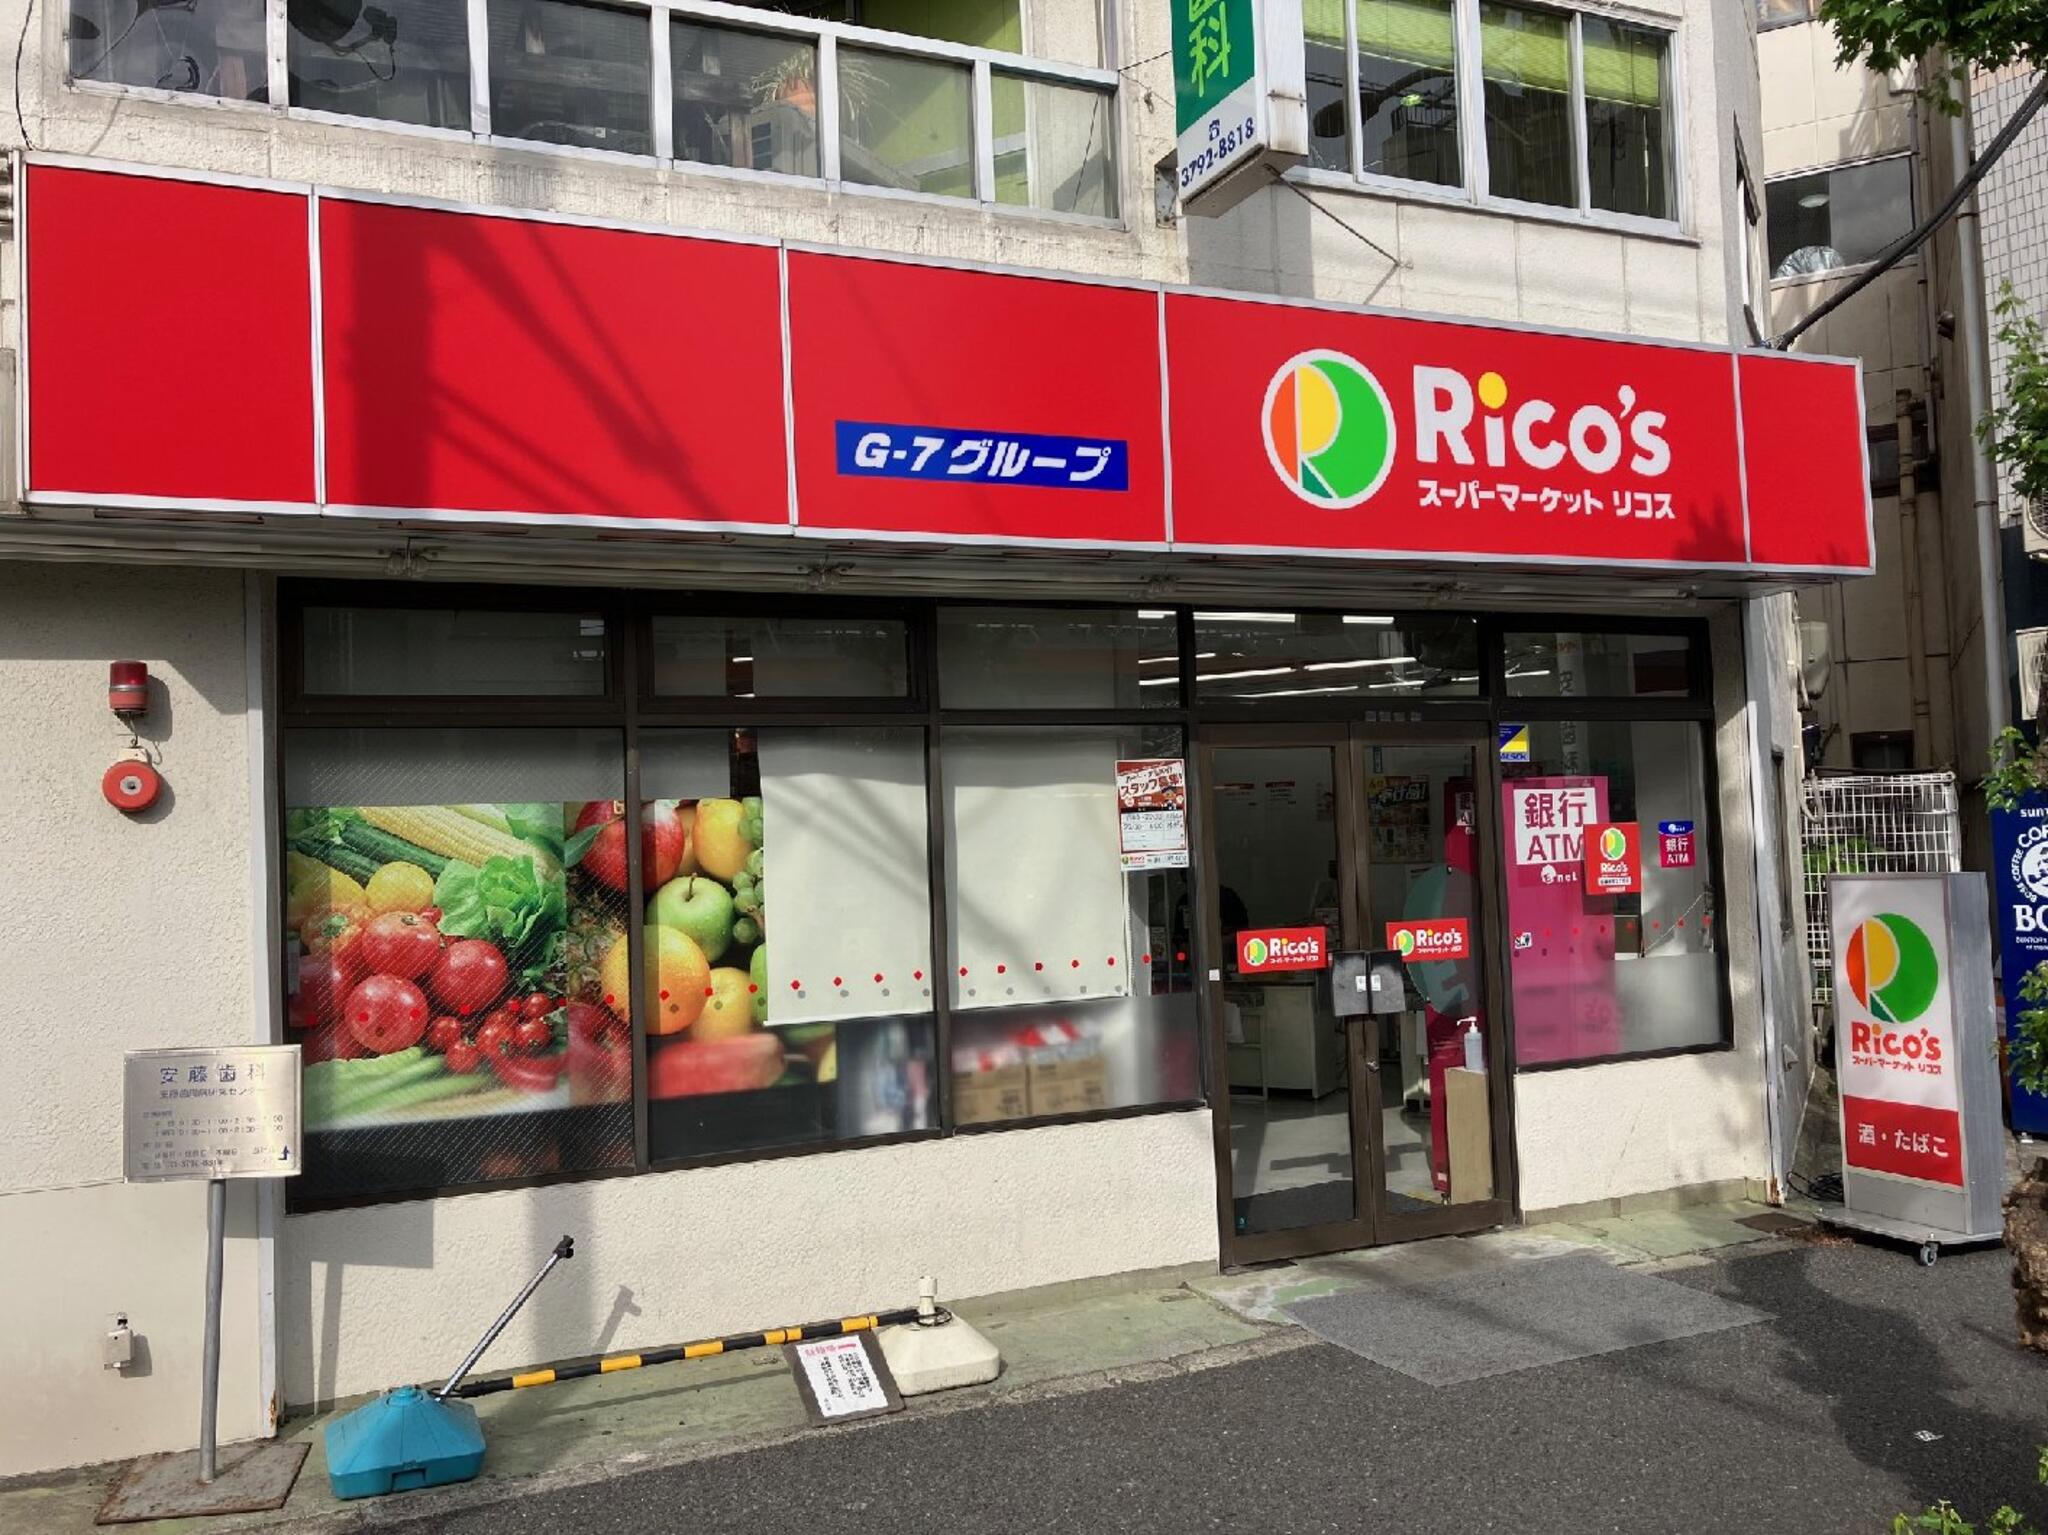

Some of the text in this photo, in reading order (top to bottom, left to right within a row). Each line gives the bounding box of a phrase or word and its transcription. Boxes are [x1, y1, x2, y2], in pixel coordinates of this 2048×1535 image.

[1181, 117, 1255, 187] 3792-8818
[1413, 364, 1671, 476] Rico's
[1418, 479, 1676, 519] スーパーマーケット リコス
[1524, 791, 1588, 829] 銀行
[1665, 838, 1689, 852] 銀行
[1667, 854, 1690, 864] ATM
[1269, 936, 1319, 956] Rico's
[1416, 927, 1462, 946] Rico's
[1851, 1021, 1941, 1061] Rico's
[160, 1062, 265, 1085] 安藤歯科
[1852, 1055, 1941, 1075] スーパーマーケット リコス
[1858, 1123, 1949, 1158] 酒・たばこ
